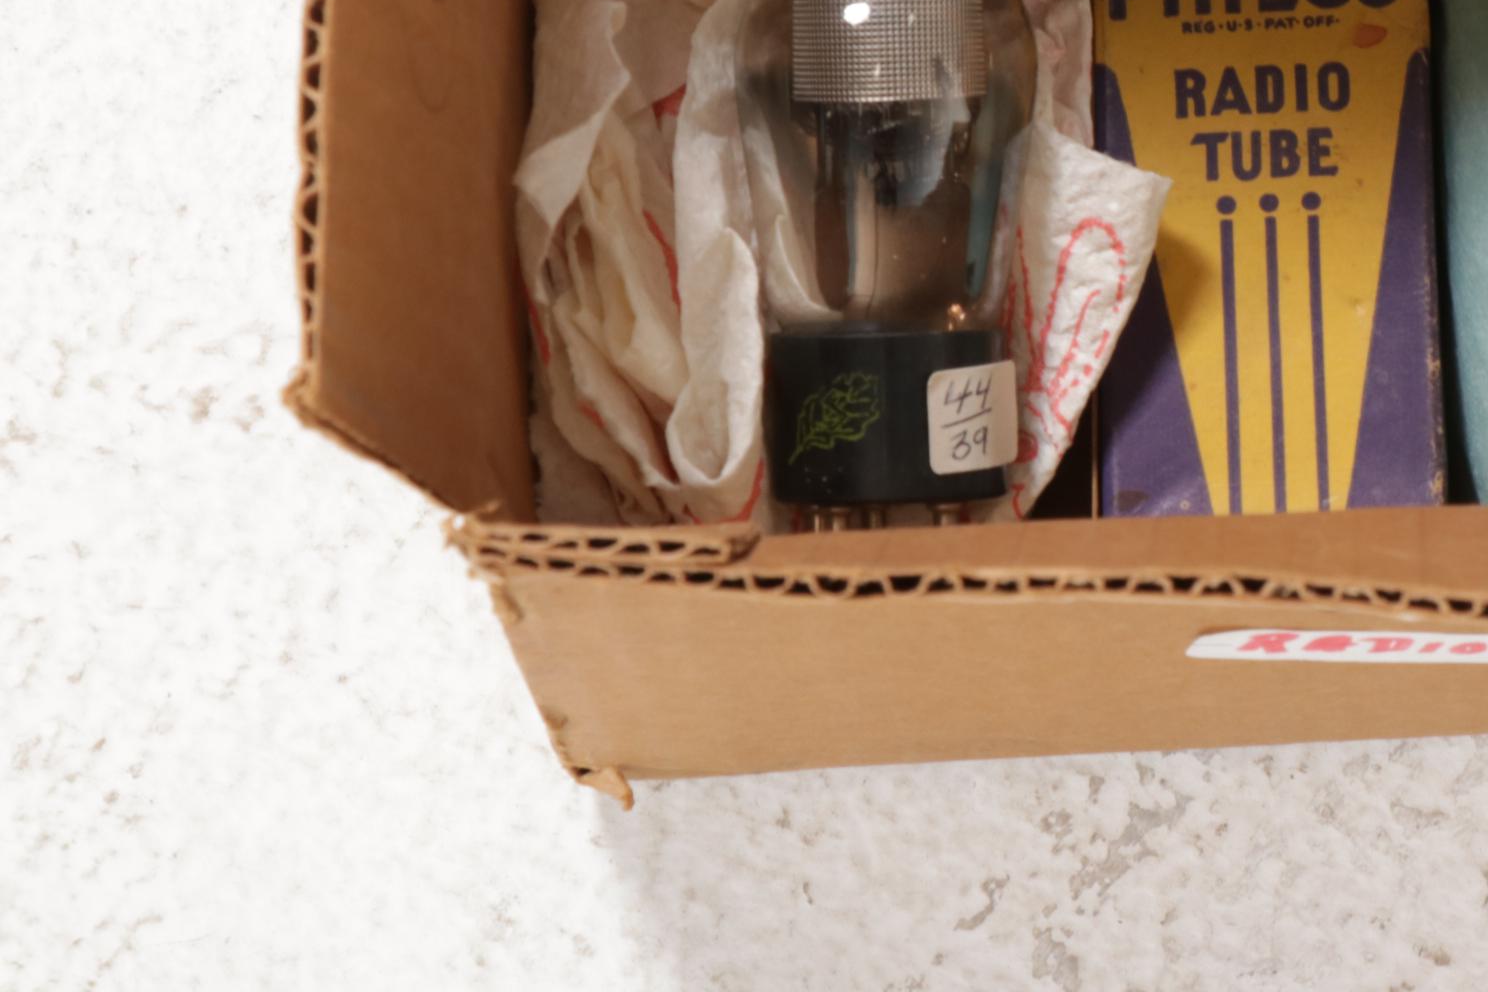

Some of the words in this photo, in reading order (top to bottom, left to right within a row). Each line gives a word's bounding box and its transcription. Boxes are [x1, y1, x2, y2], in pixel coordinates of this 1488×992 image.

[1173, 61, 1351, 119] RADIO
[1190, 127, 1339, 182] TUBE
[943, 372, 993, 415] 44
[950, 427, 989, 461] 39
